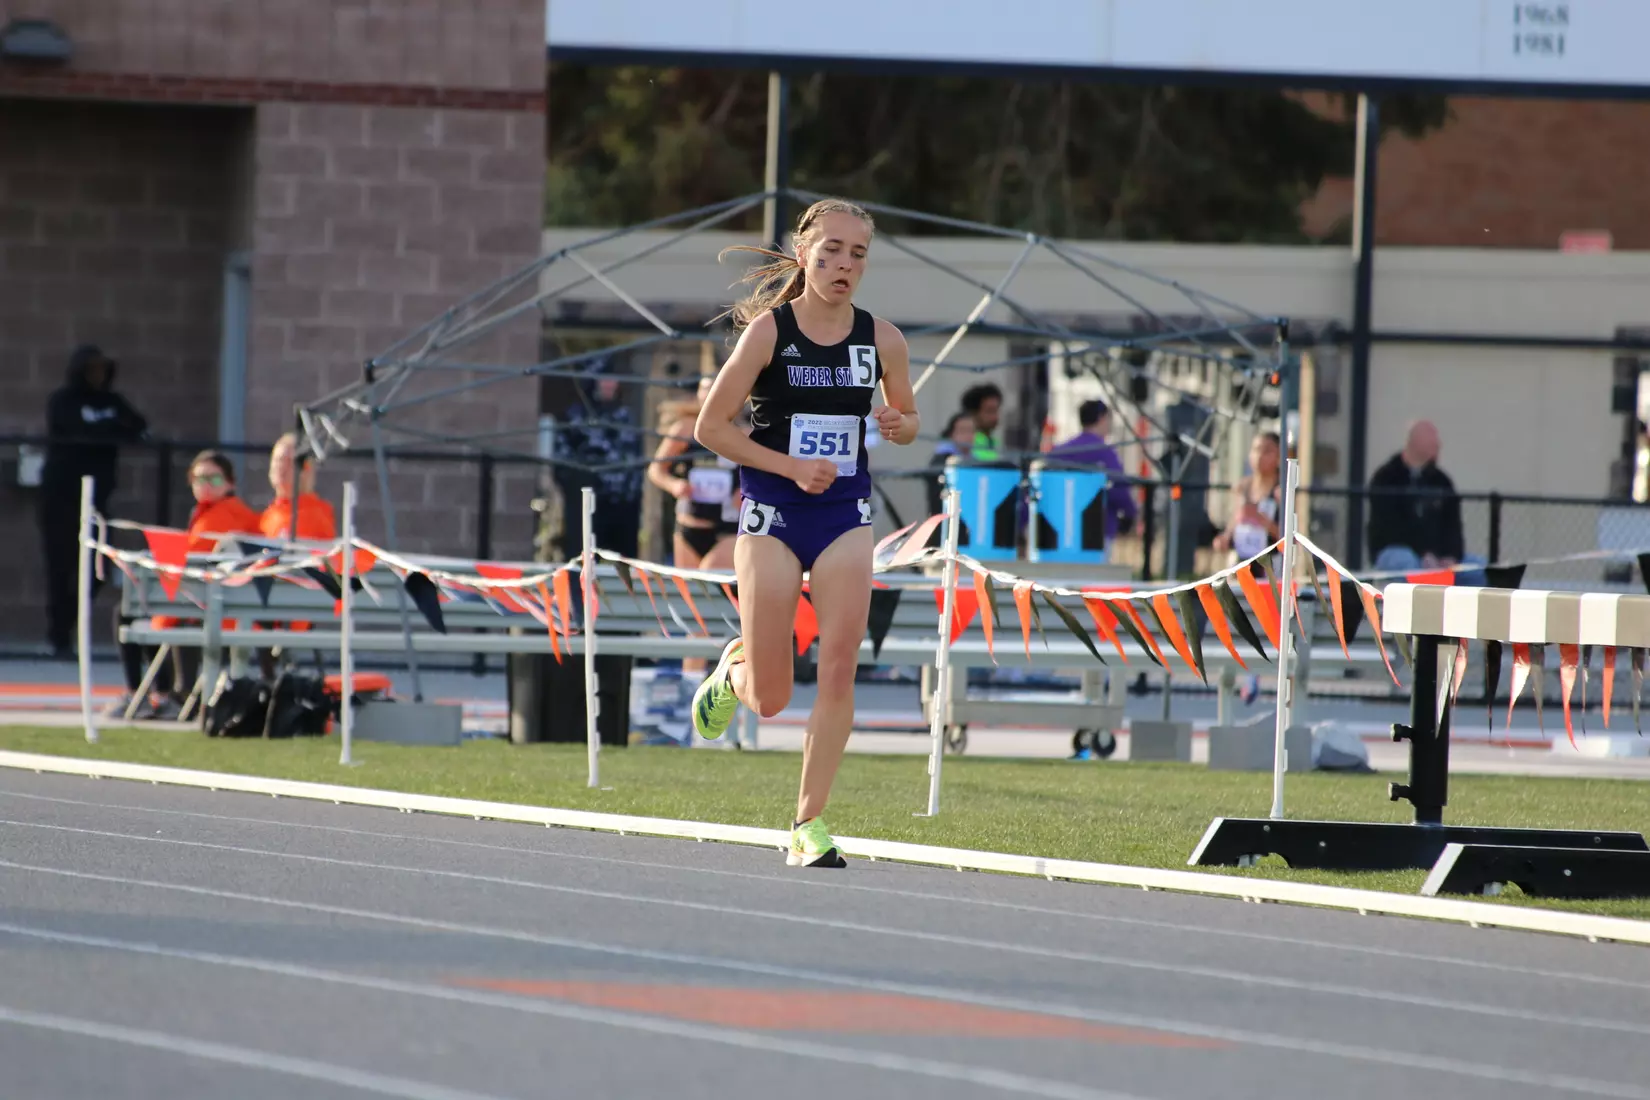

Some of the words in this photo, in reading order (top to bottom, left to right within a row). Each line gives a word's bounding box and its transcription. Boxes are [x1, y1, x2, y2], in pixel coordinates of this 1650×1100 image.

[787, 364, 834, 387] WEBER
[856, 347, 872, 385] 5
[799, 430, 851, 457] 551
[747, 501, 765, 533] 5
